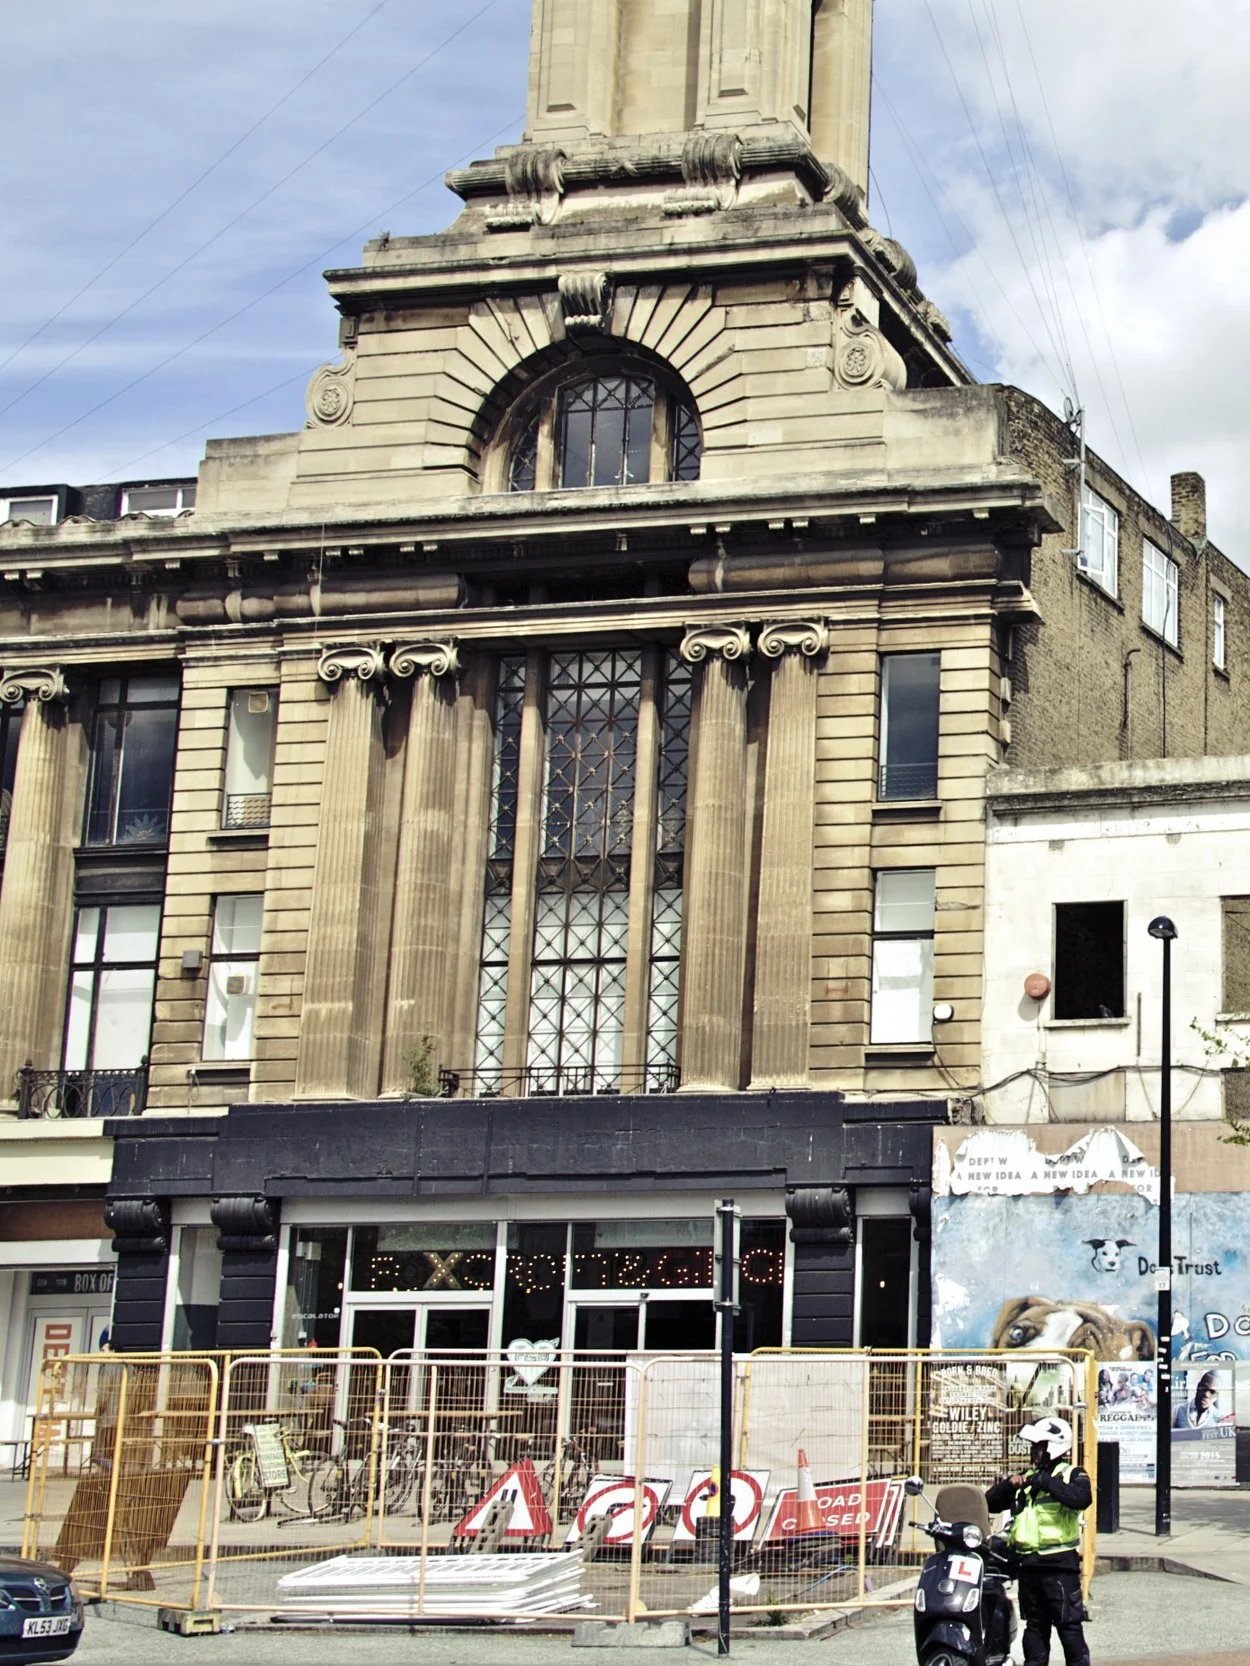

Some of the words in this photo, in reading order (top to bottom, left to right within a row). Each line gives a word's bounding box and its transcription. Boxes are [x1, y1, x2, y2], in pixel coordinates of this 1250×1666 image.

[968, 1172, 992, 1180] NEW
[996, 1171, 1022, 1180] IDEA
[1031, 1171, 1038, 1180] A
[1043, 1170, 1068, 1179] NEW
[1072, 1169, 1098, 1178] IDEA
[1108, 1170, 1116, 1178] A
[1121, 1169, 1146, 1178] NEW
[1173, 1256, 1223, 1275] Trust
[74, 1273, 97, 1292] BOX
[99, 1273, 114, 1292] OF
[949, 1406, 987, 1421] WILEY
[932, 1421, 969, 1433] GOLDIE
[976, 1421, 1001, 1433] ZINC
[1220, 1426, 1236, 1438] UK
[263, 1469, 288, 1481] STORE
[816, 1493, 863, 1509] OAD
[781, 1511, 871, 1531] CSED
[957, 1561, 972, 1577] L
[27, 1619, 53, 1635] KL53
